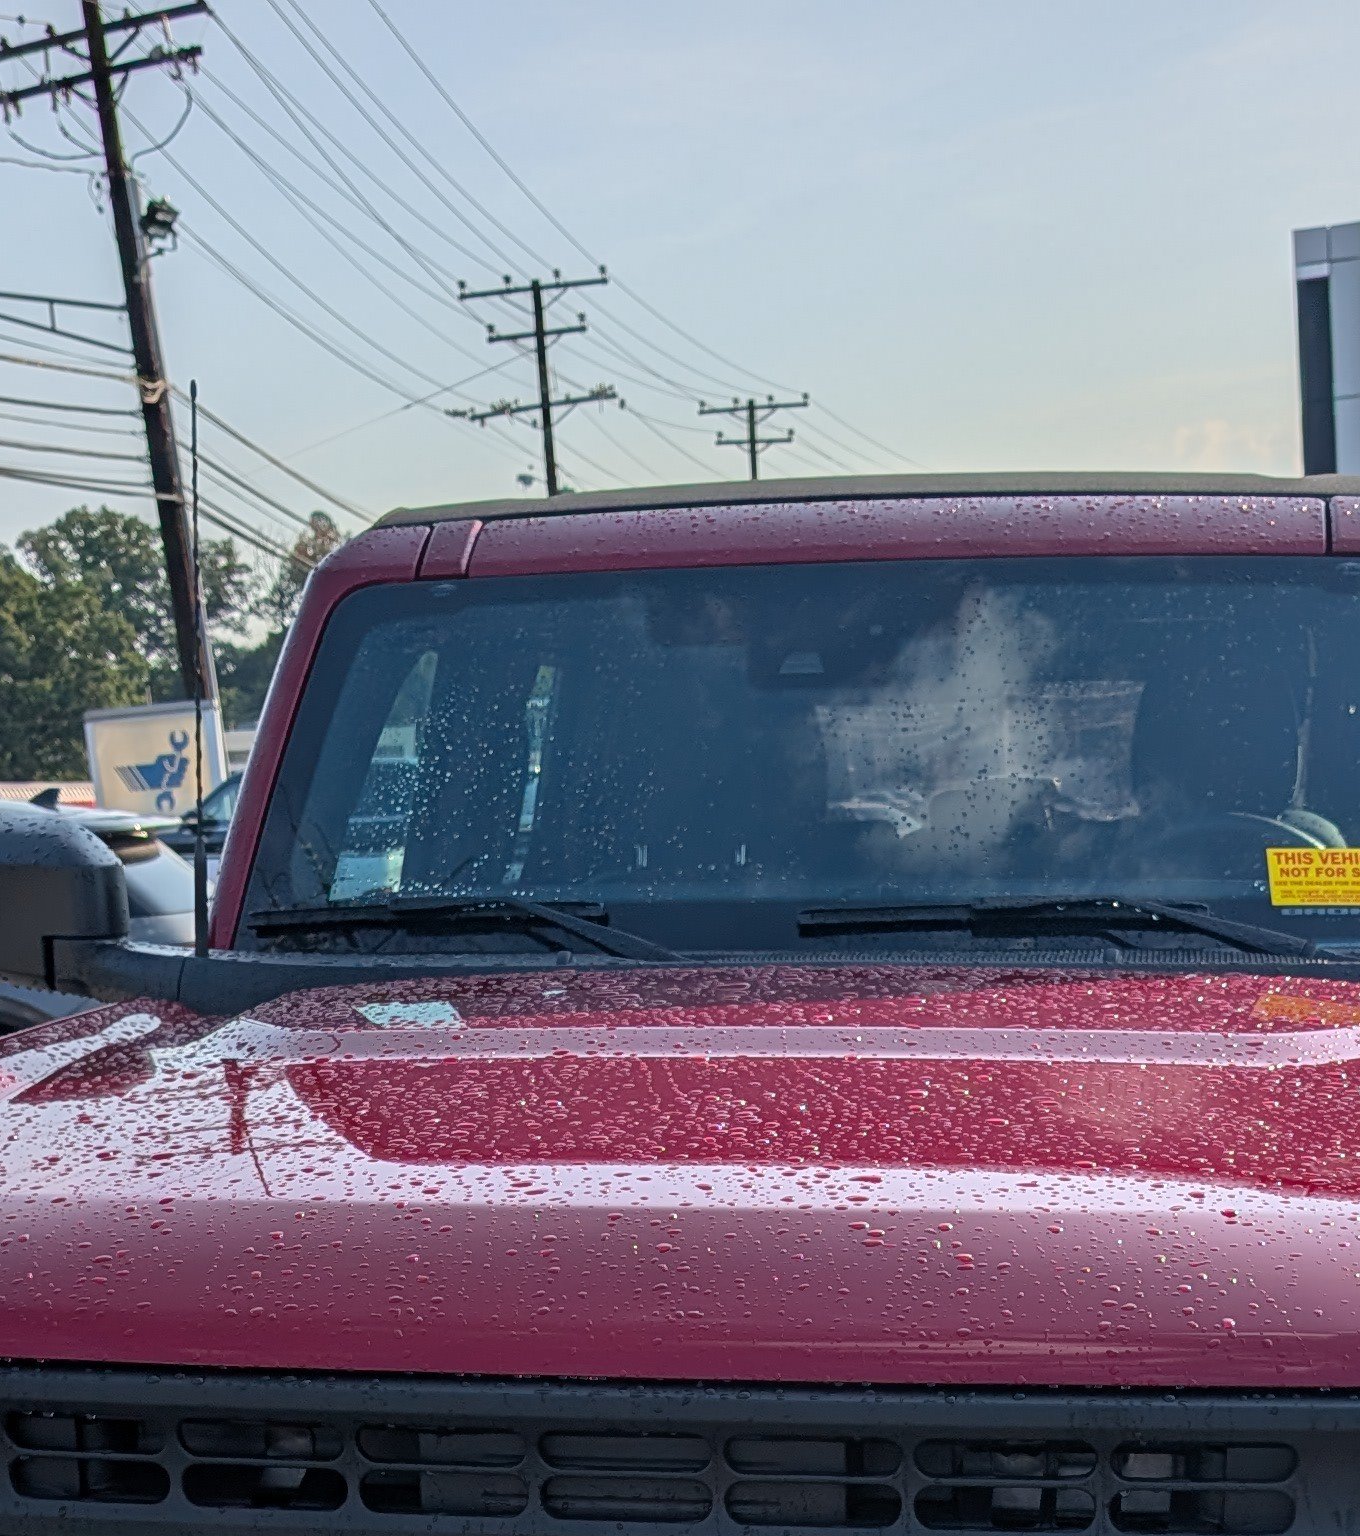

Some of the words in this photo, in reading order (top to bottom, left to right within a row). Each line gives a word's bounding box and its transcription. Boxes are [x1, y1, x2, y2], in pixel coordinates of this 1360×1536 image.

[1274, 852, 1313, 865] THIS
[1280, 868, 1310, 878] NOT
[1316, 868, 1346, 878] FOR
